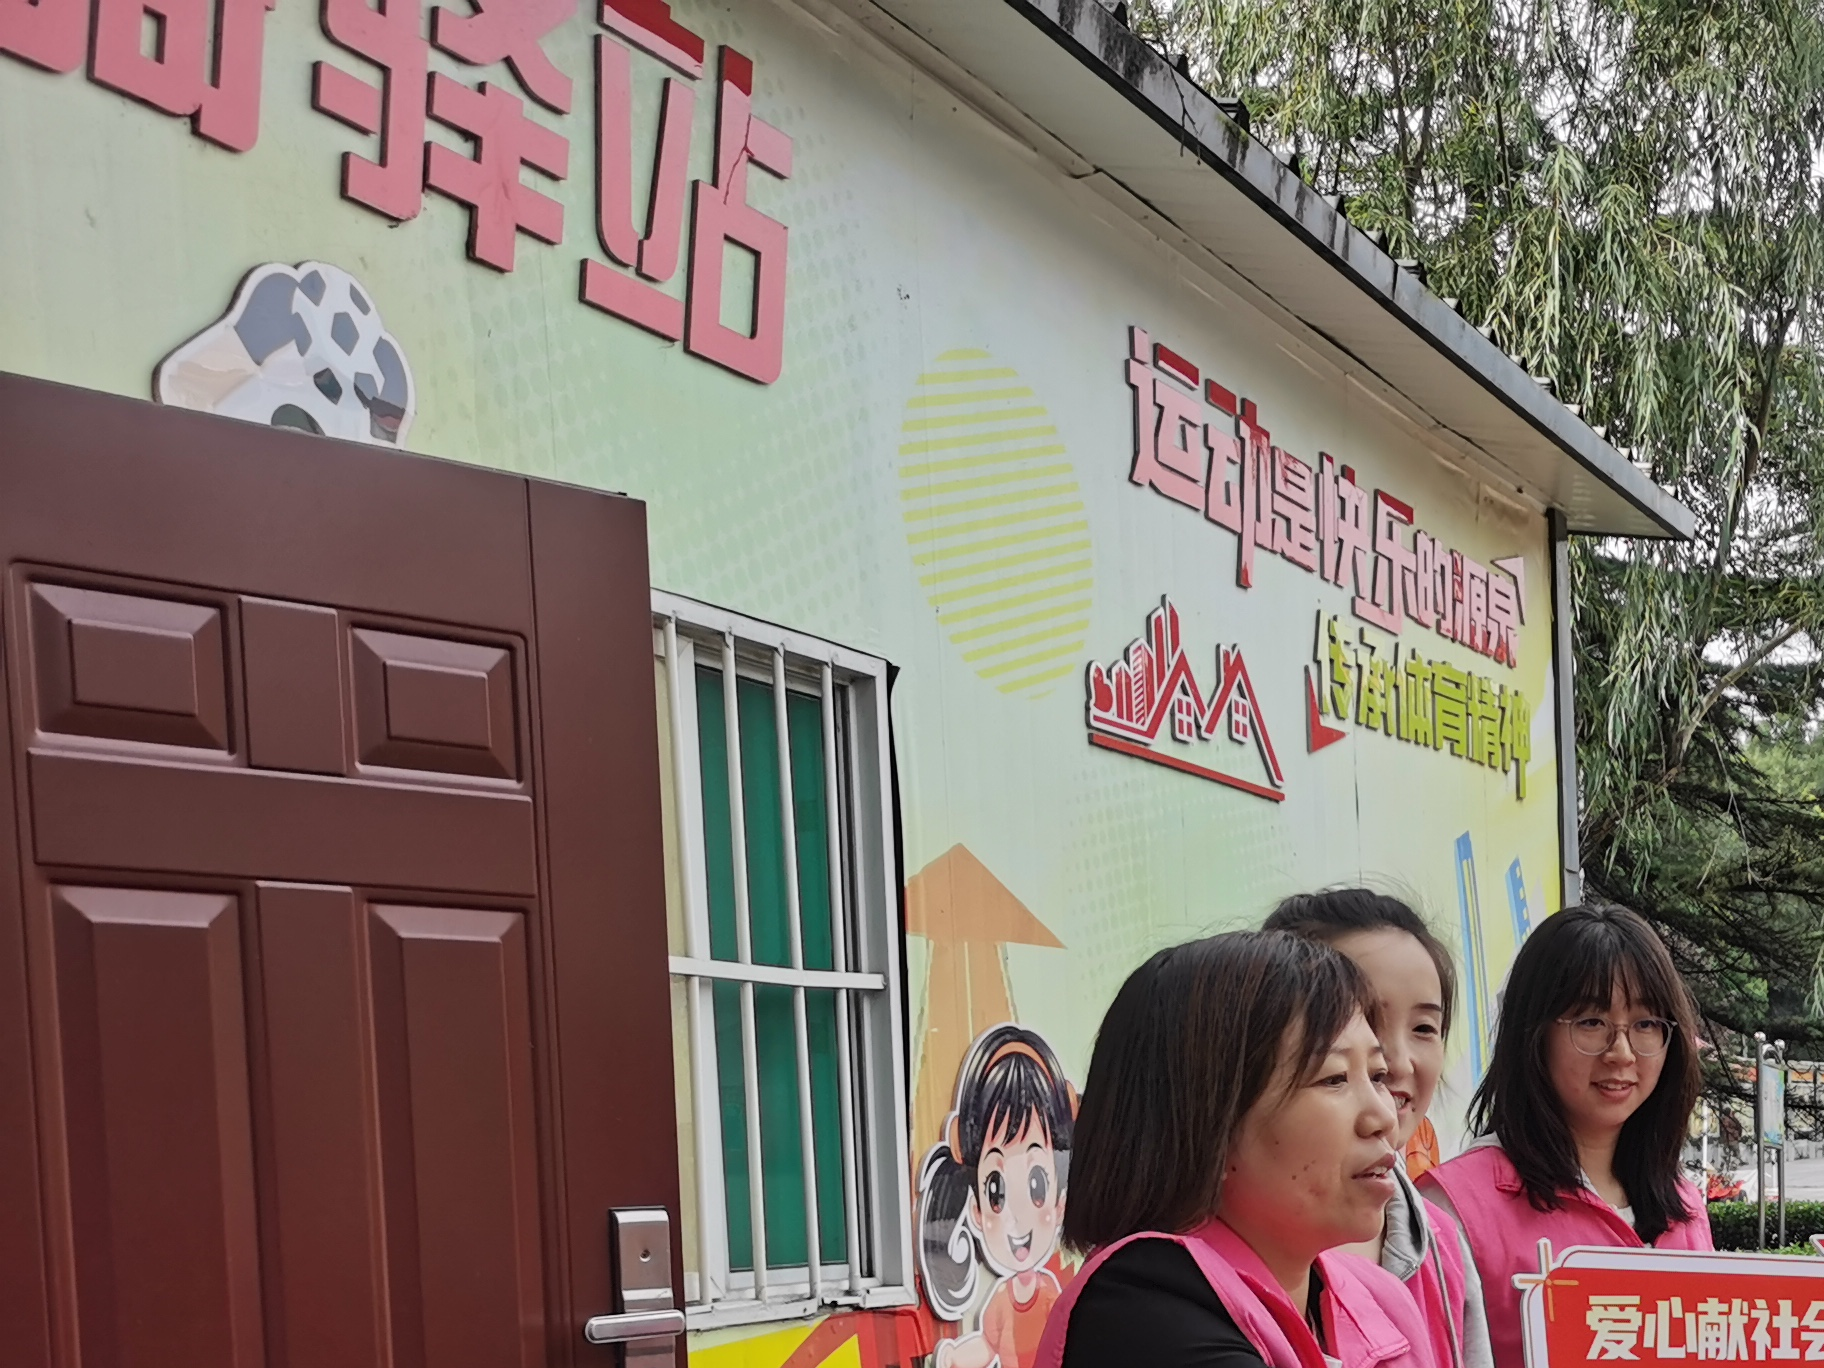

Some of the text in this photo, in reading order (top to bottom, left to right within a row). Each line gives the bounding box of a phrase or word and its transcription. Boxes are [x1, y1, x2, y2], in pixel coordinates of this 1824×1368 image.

[1125, 325, 1522, 669] 运动是快乐的源泉
[1313, 609, 1532, 801] 传承体育精神
